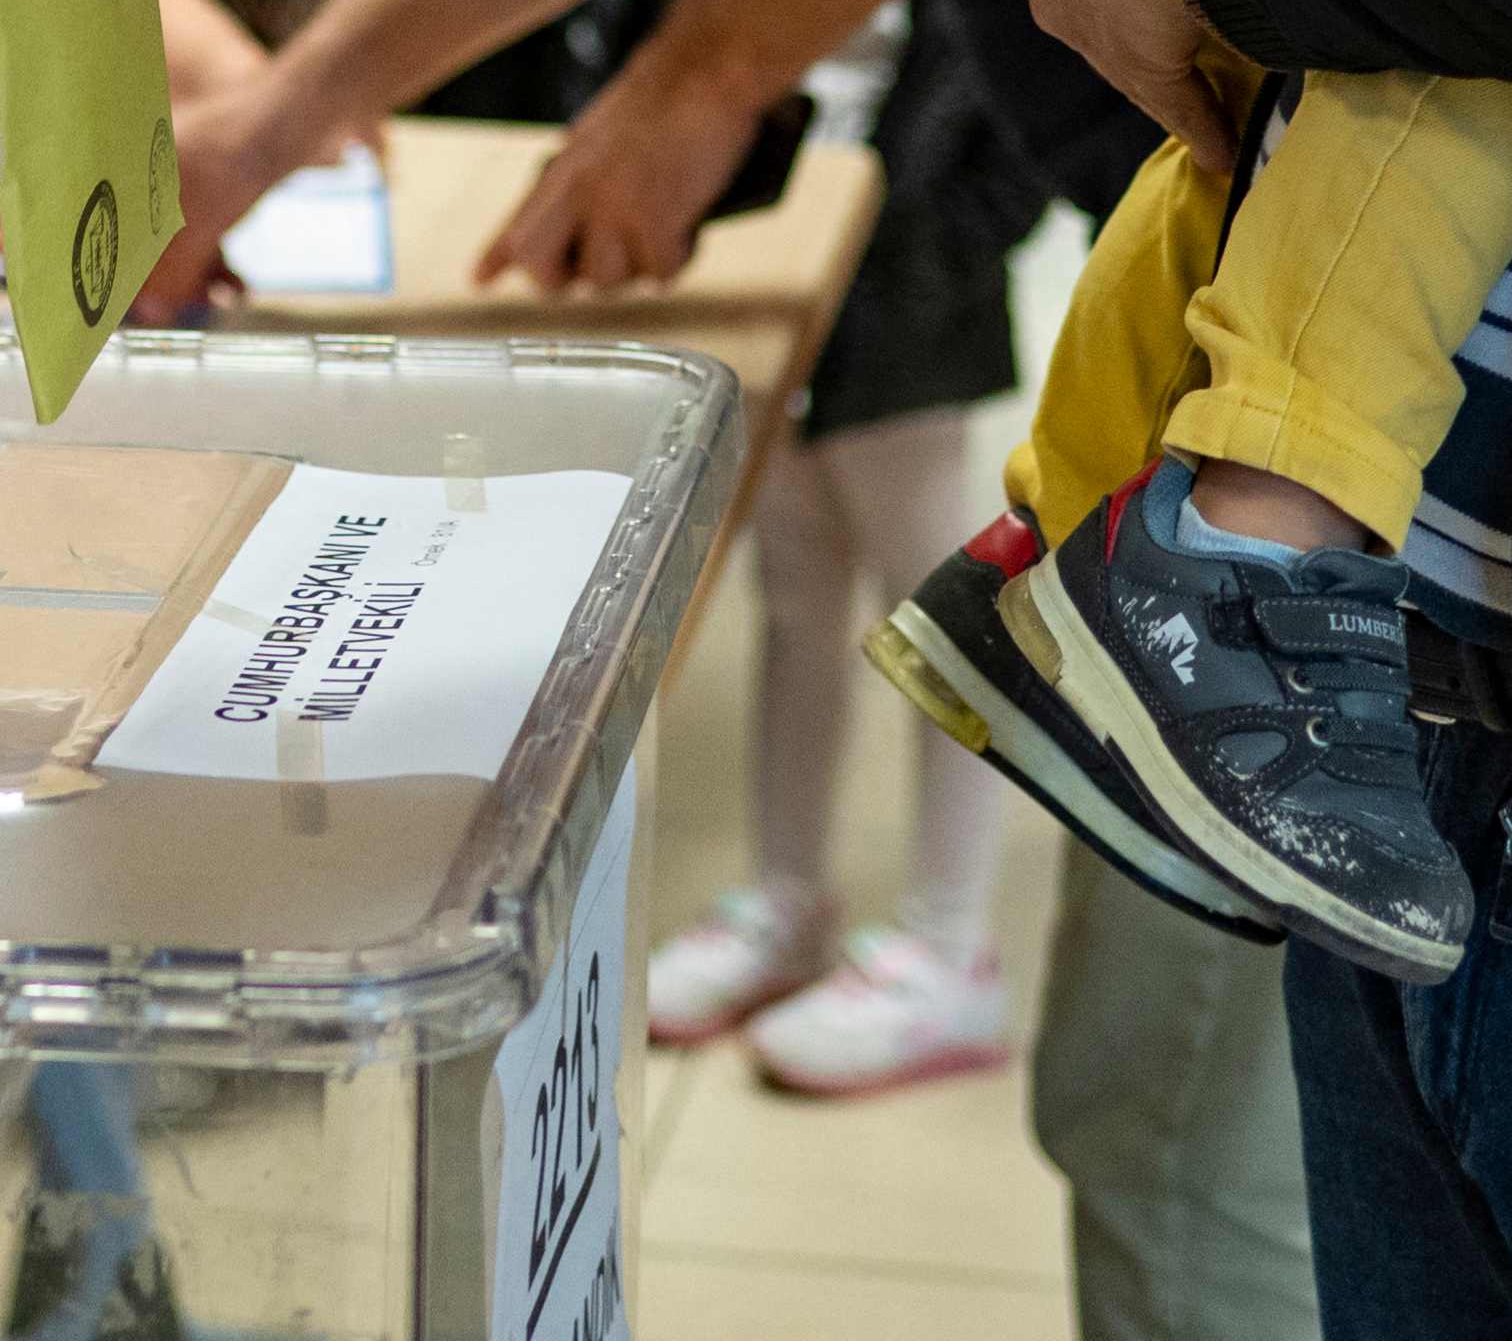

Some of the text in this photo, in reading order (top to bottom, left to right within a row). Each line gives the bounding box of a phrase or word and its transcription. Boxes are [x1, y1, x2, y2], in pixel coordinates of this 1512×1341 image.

[214, 515, 388, 722] CUMHURBAŞKANI VE
[295, 582, 425, 722] MİLLETVEKİLİ
[528, 950, 599, 1293] 2213
